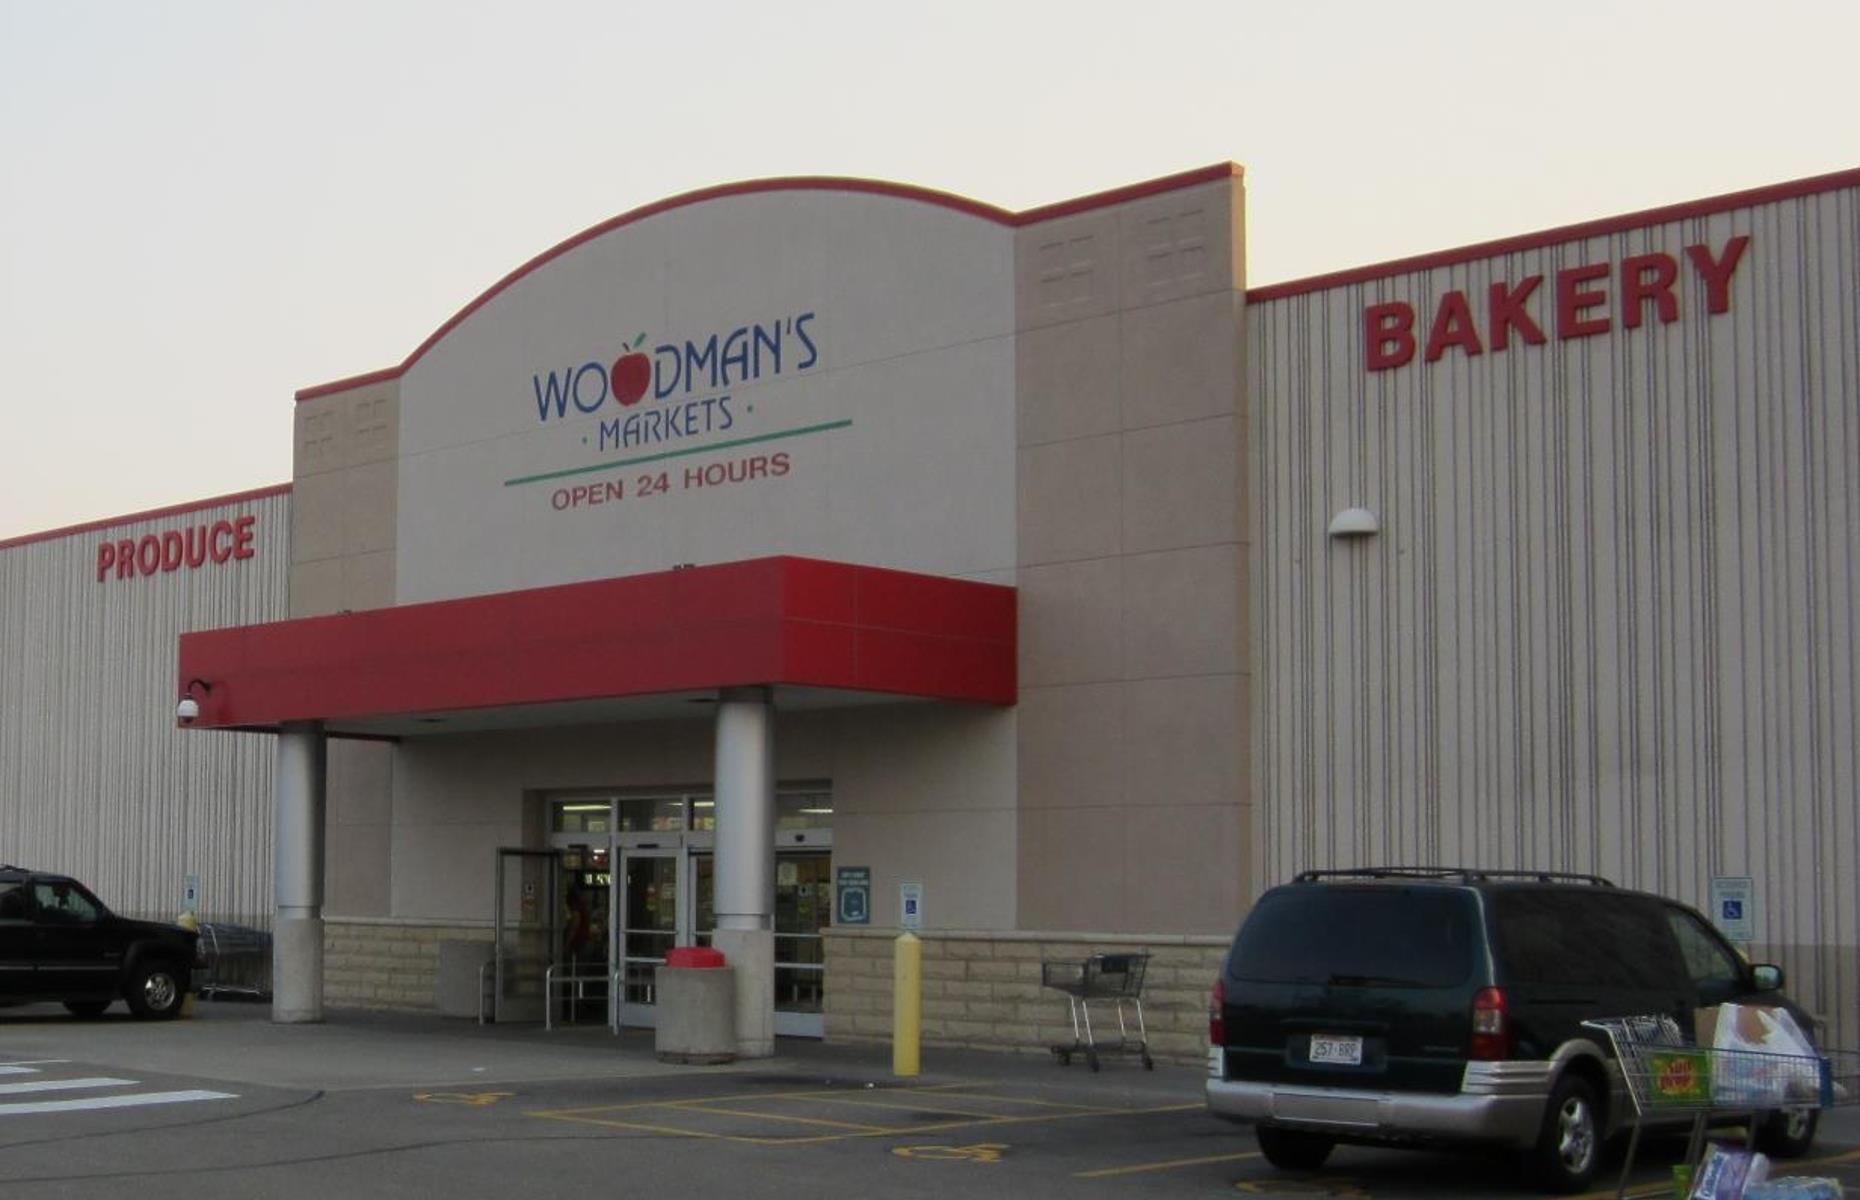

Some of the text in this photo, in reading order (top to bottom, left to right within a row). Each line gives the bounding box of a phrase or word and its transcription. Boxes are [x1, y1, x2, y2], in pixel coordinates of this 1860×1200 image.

[1365, 236, 1750, 371] BAKERY
[533, 312, 818, 422] WOODMAN'S
[599, 396, 733, 452] MARKETS
[551, 452, 791, 511] OPEN 24 HOURS
[97, 516, 256, 582] PRODUCE
